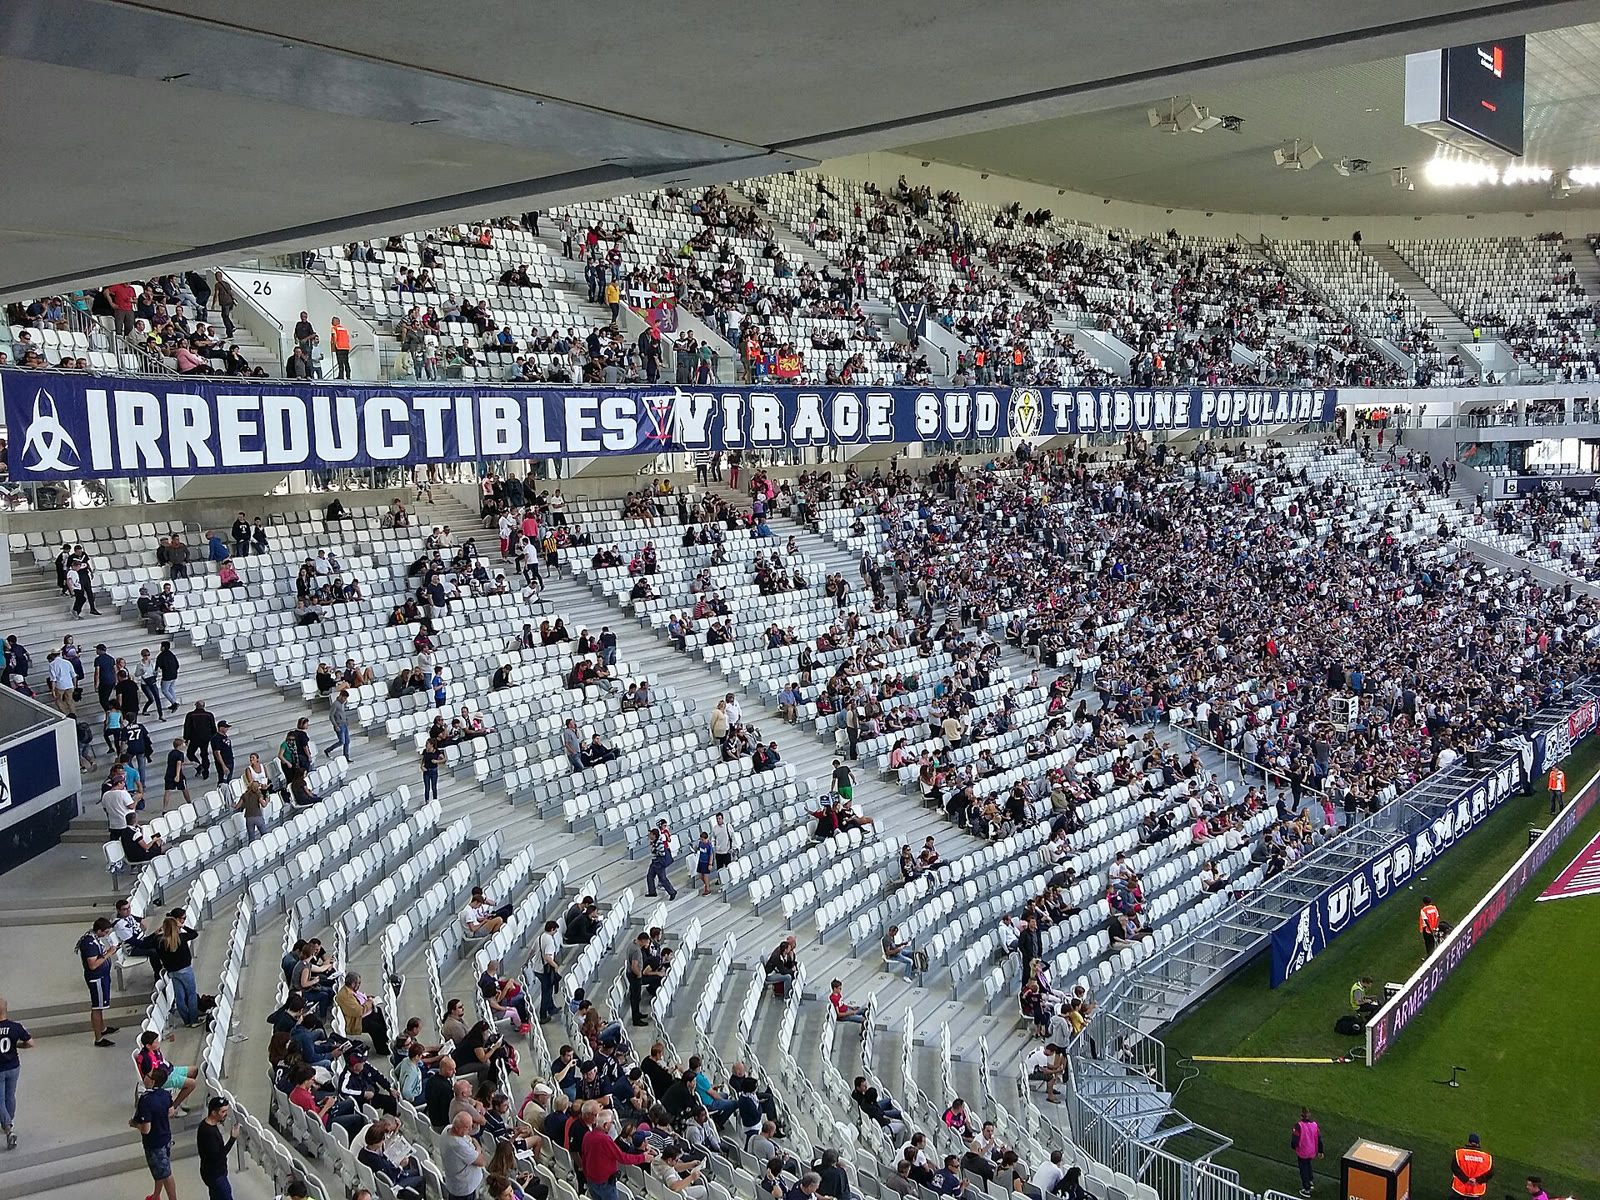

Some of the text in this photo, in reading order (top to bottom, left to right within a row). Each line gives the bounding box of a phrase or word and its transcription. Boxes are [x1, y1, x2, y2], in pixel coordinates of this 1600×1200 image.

[253, 280, 272, 296] 26
[86, 389, 638, 471] IRREDUCTIBLES
[678, 390, 1326, 450] VIRAGE SUD TRIBUNE POPULAIRE
[128, 729, 141, 741] 27
[1328, 758, 1520, 932] ULTRAMARINE
